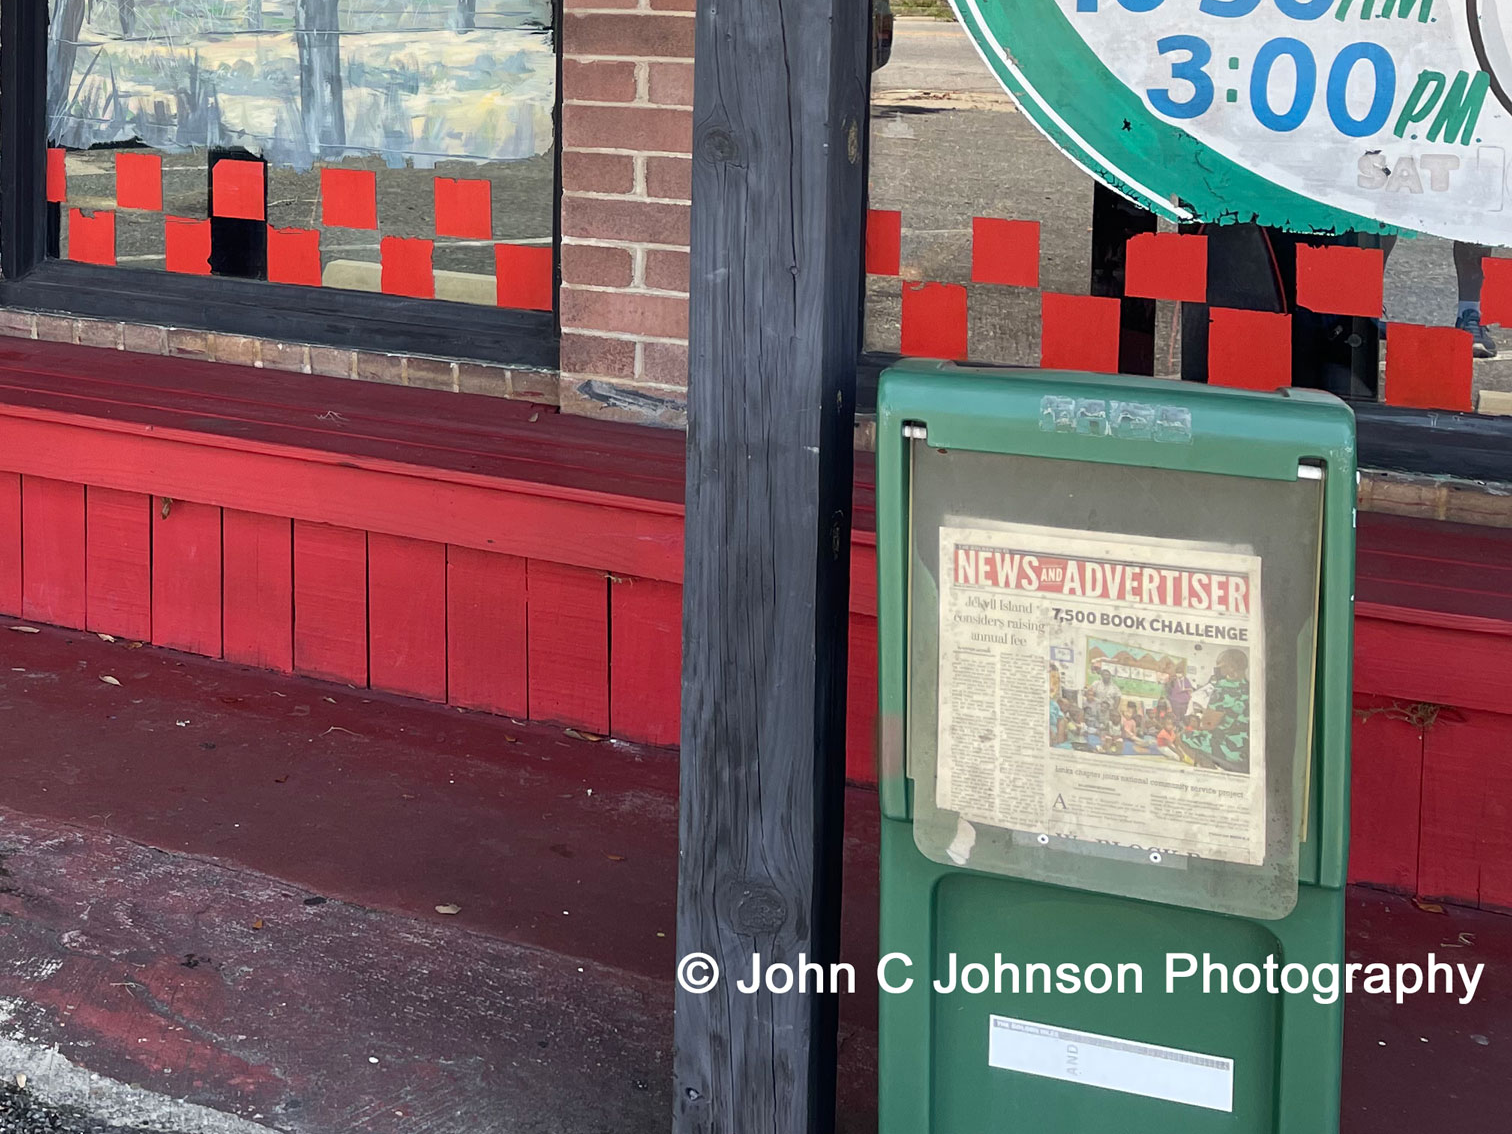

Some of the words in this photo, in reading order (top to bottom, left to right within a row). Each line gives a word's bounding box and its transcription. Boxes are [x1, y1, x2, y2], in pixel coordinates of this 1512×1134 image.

[1145, 34, 1397, 138] 3:00
[1357, 152, 1461, 195] SAT
[957, 549, 1040, 592] NEWS
[1041, 567, 1063, 582] AND
[1063, 560, 1248, 614] ADVERTISER
[965, 596, 997, 611] Jekyll
[1000, 599, 1033, 614] Island
[954, 613, 1005, 628] considers
[1007, 619, 1045, 634] raising
[1052, 607, 1097, 624] 7,500
[1100, 612, 1146, 631] BOOK
[1149, 618, 1249, 642] CHALLENGE
[970, 631, 1008, 645] annual
[1010, 633, 1027, 646] fee
[1150, 780, 1188, 792] community
[1190, 784, 1217, 795] service
[1218, 789, 1244, 799] project
